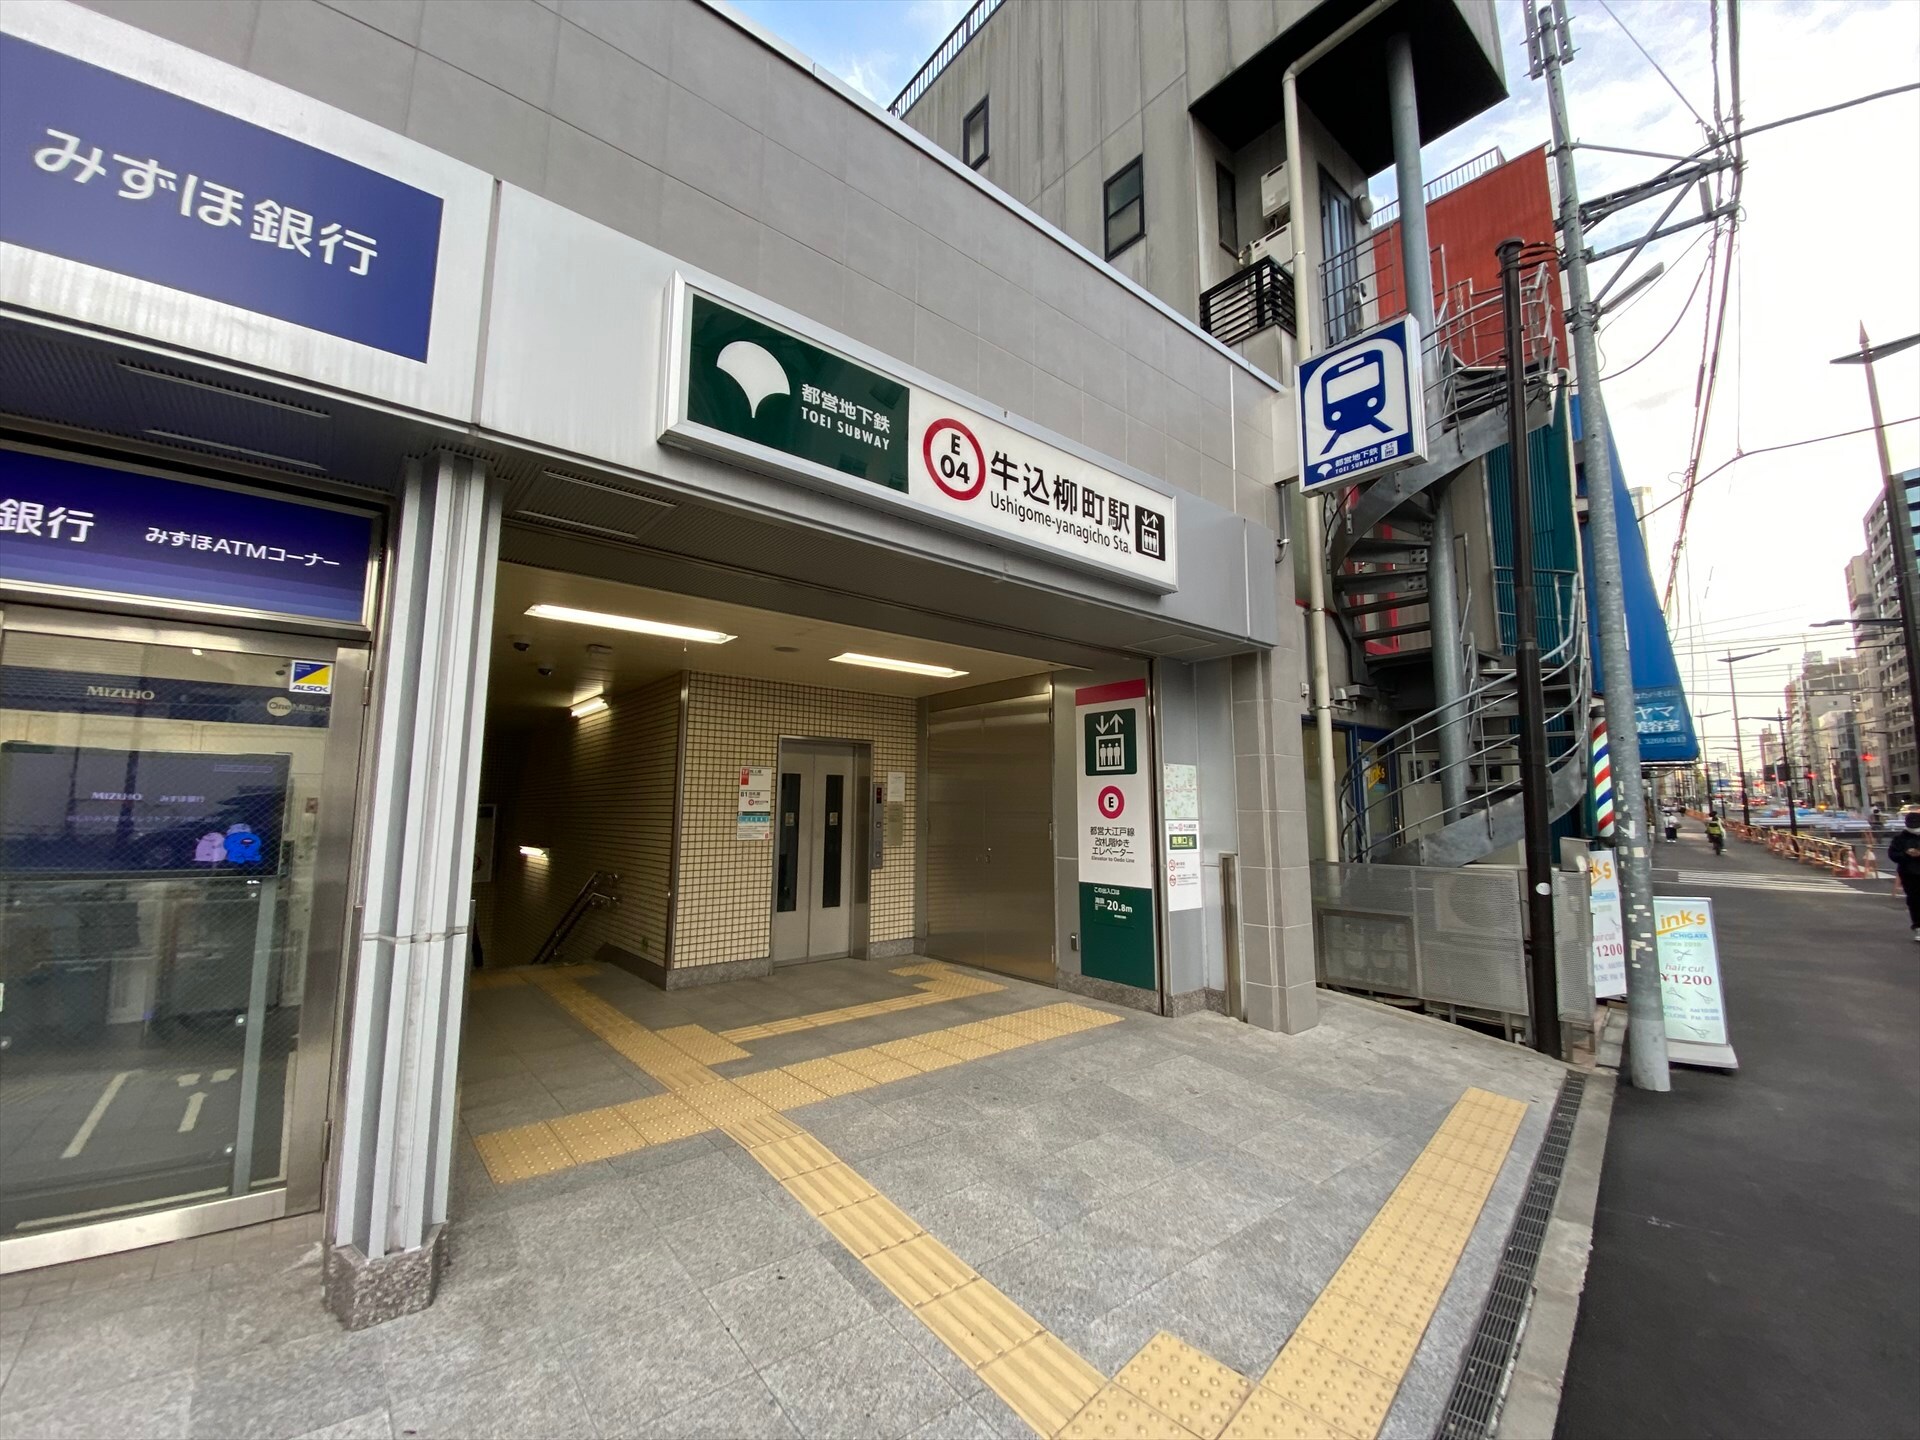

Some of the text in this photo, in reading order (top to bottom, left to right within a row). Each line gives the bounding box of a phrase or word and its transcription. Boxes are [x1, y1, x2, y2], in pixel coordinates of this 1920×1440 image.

[34, 128, 378, 276] みずほ銀行
[801, 383, 890, 434] 都営地下鉄
[801, 406, 890, 450] TOEI SUBWAY
[950, 433, 961, 456] E
[1335, 447, 1379, 468] 都営地下鉄
[1335, 455, 1379, 475] TOEI SUBWAY
[940, 454, 970, 484] 04
[990, 450, 1130, 535] 牛込柳町駅
[990, 490, 1132, 555] Ushigome-yanagicho Sta.
[145, 527, 340, 567] みずほATMコーナー
[86, 685, 155, 700] MIZUHO
[292, 684, 329, 693] ALSOK
[91, 791, 143, 801] MIZUHO
[1108, 796, 1115, 809] E
[1090, 826, 1135, 837] 都営大江戸線
[1094, 837, 1130, 848] 改札階ゆき
[1092, 846, 1134, 857] エレベーター
[1106, 899, 1133, 913] 20.8m
[1596, 943, 1622, 957] 1200
[1665, 963, 1704, 973] hair cut
